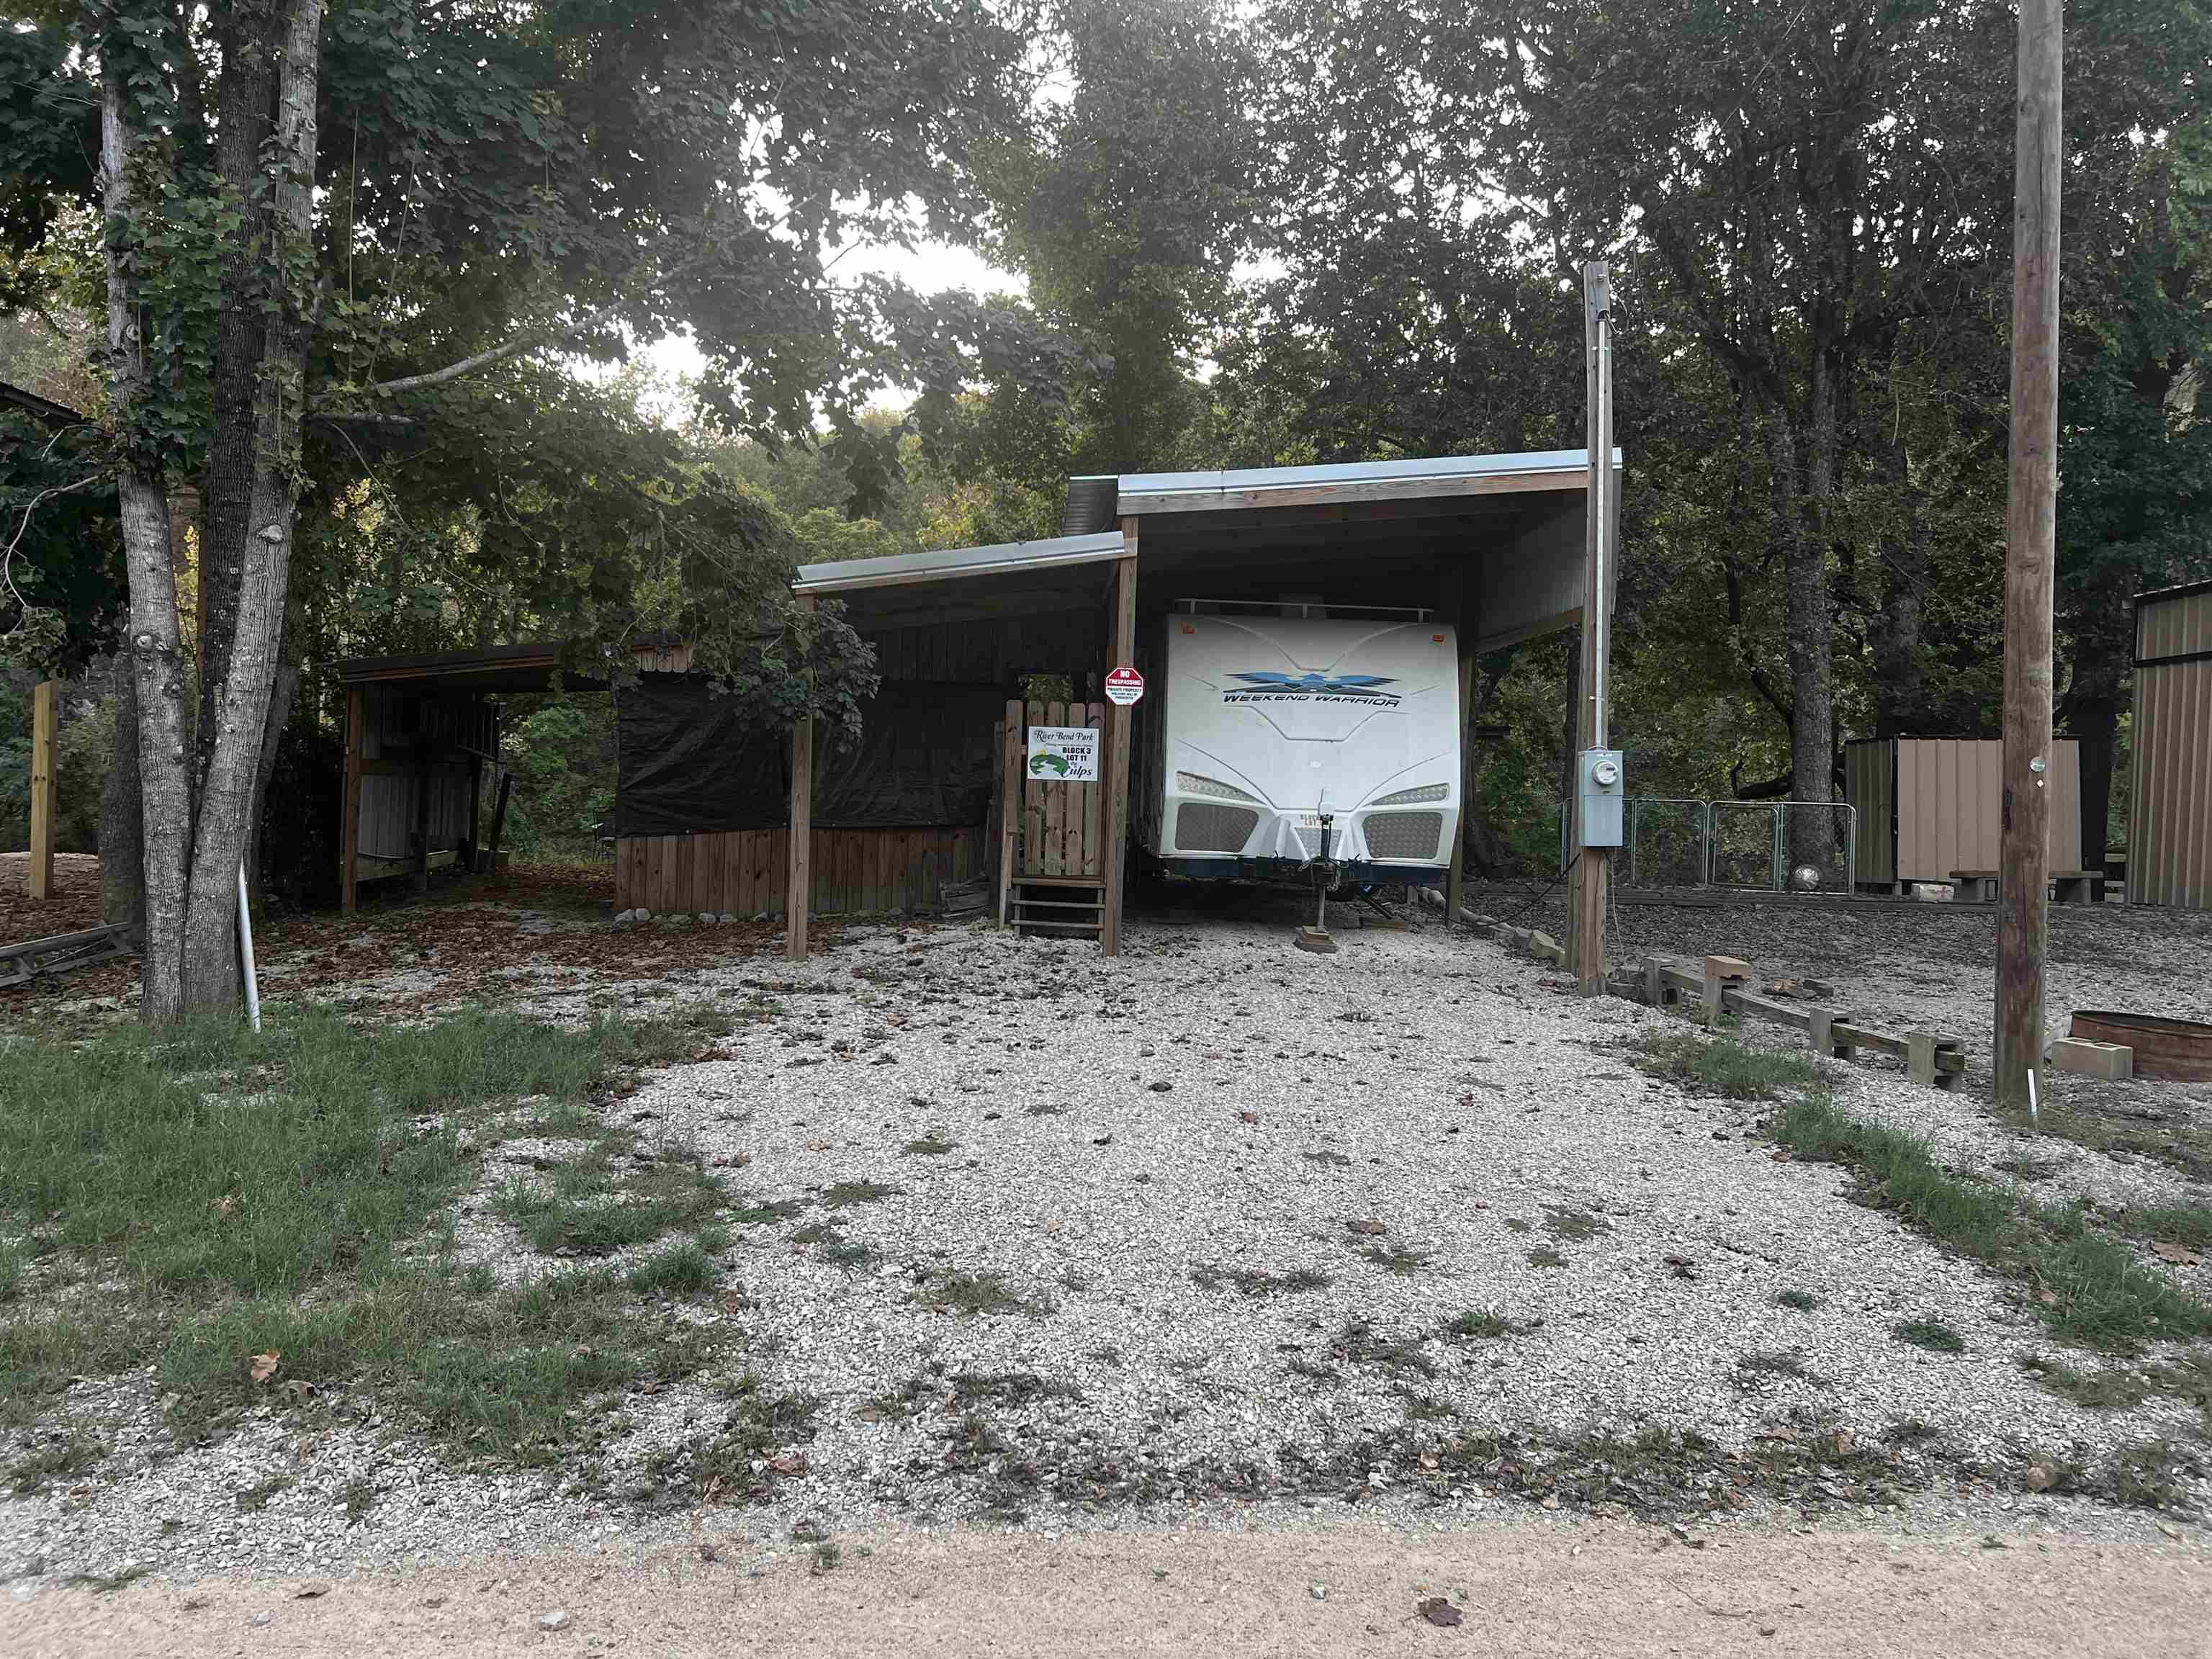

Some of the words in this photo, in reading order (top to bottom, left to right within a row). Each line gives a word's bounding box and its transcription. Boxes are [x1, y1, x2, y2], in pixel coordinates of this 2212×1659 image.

[1223, 693, 1310, 703] WEEKEND
[1315, 695, 1401, 709] WARRIOR
[1034, 729, 1055, 742] River
[1056, 731, 1074, 741] Bend
[1075, 732, 1094, 741] Park
